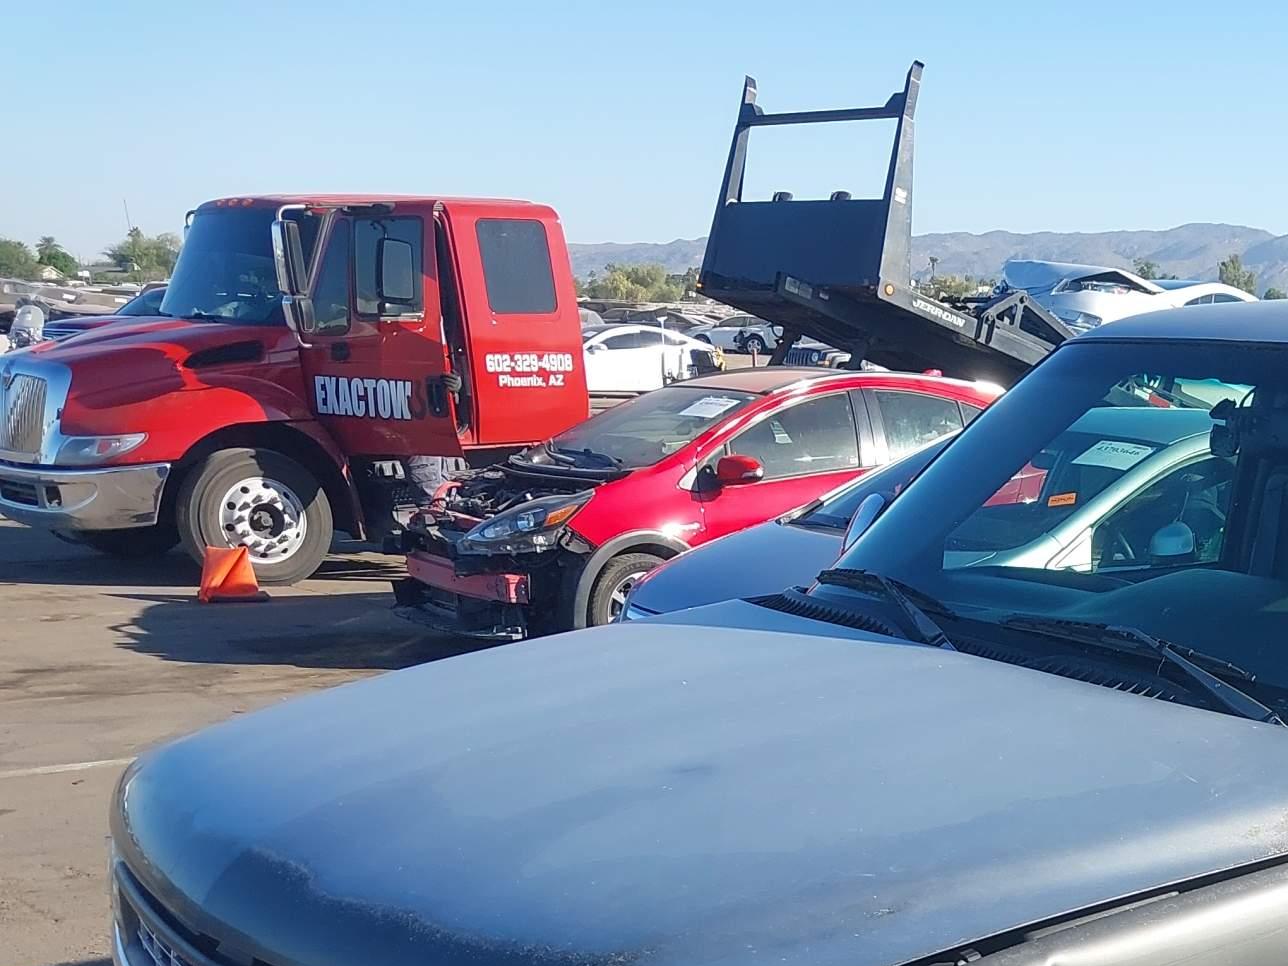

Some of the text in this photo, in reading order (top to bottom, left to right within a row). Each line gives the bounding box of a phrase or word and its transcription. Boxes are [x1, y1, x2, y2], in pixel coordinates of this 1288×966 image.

[485, 353, 574, 373] 602-329-4908
[498, 374, 564, 388] Phoenix, AZ
